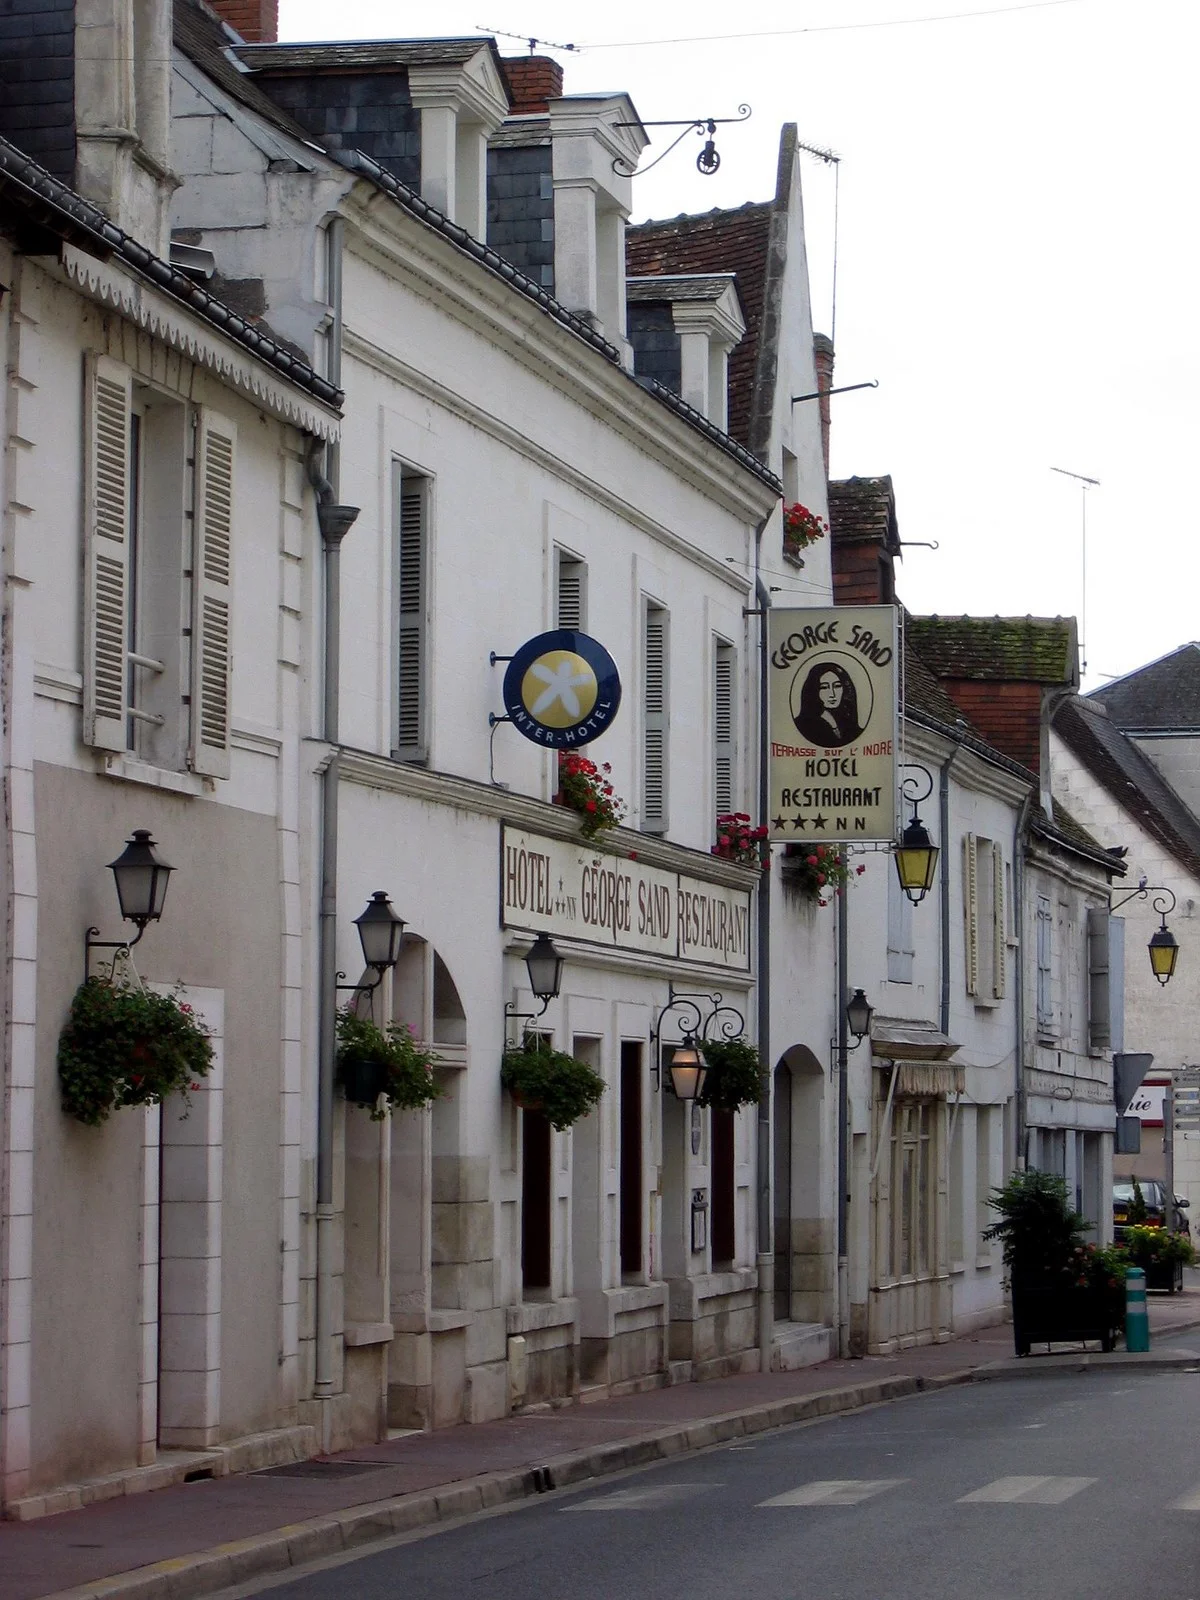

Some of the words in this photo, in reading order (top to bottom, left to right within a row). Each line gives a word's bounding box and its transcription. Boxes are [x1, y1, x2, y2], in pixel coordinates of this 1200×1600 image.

[771, 620, 839, 670] GEORGE
[845, 624, 893, 668] SAND
[511, 701, 612, 742] INTER-HOTEL
[771, 742, 817, 757] TERRASSE
[863, 740, 892, 756] INDRE
[805, 758, 858, 777] HOTEL
[781, 787, 882, 807] RESTAURANT
[506, 838, 553, 916] HÔTEL
[581, 865, 632, 942] GEORGE
[638, 878, 671, 939] SAND
[677, 889, 748, 963] RESTAURANT
